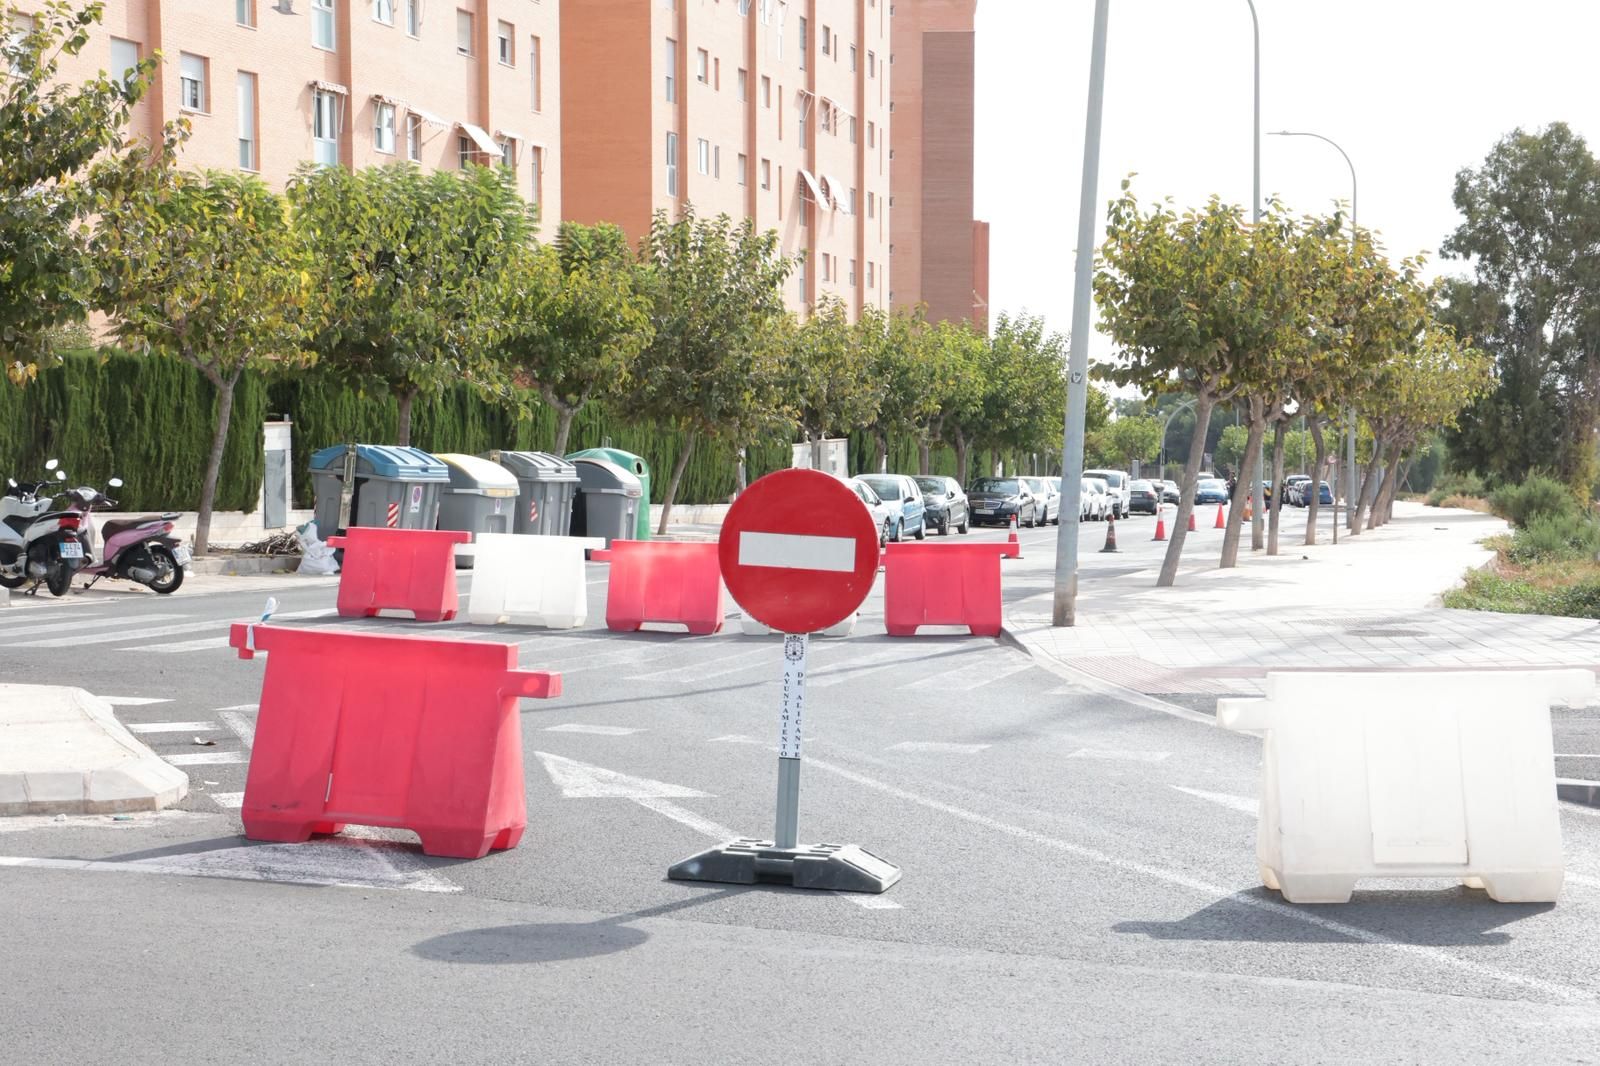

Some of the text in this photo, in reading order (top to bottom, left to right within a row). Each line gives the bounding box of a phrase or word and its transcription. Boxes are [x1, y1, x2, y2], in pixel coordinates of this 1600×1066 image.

[780, 672, 790, 757] AYUNTAMIENTO
[794, 672, 804, 757] DE ALICANTE
